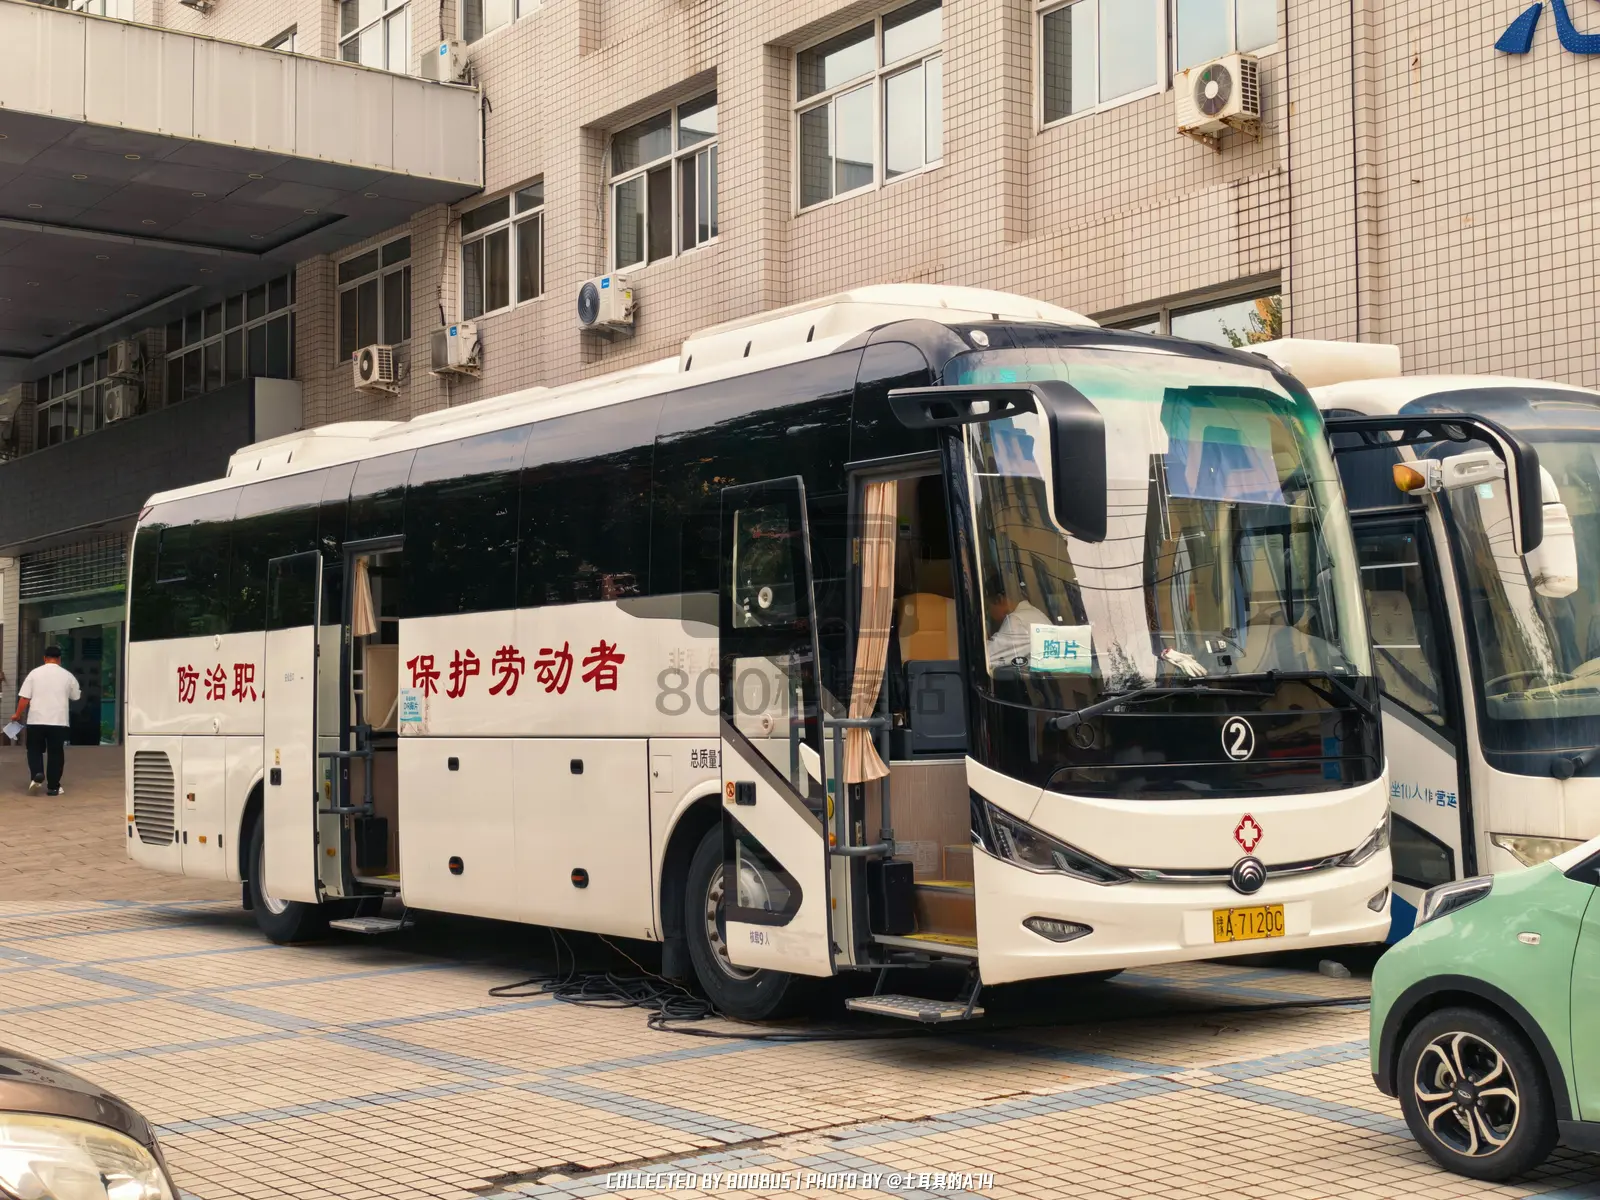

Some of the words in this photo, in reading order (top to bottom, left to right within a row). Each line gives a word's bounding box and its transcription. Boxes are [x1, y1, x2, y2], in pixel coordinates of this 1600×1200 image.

[1043, 639, 1080, 660] 胸片
[177, 663, 265, 704] 防治职
[406, 639, 626, 699] 保护劳动者
[1229, 722, 1249, 756] 2
